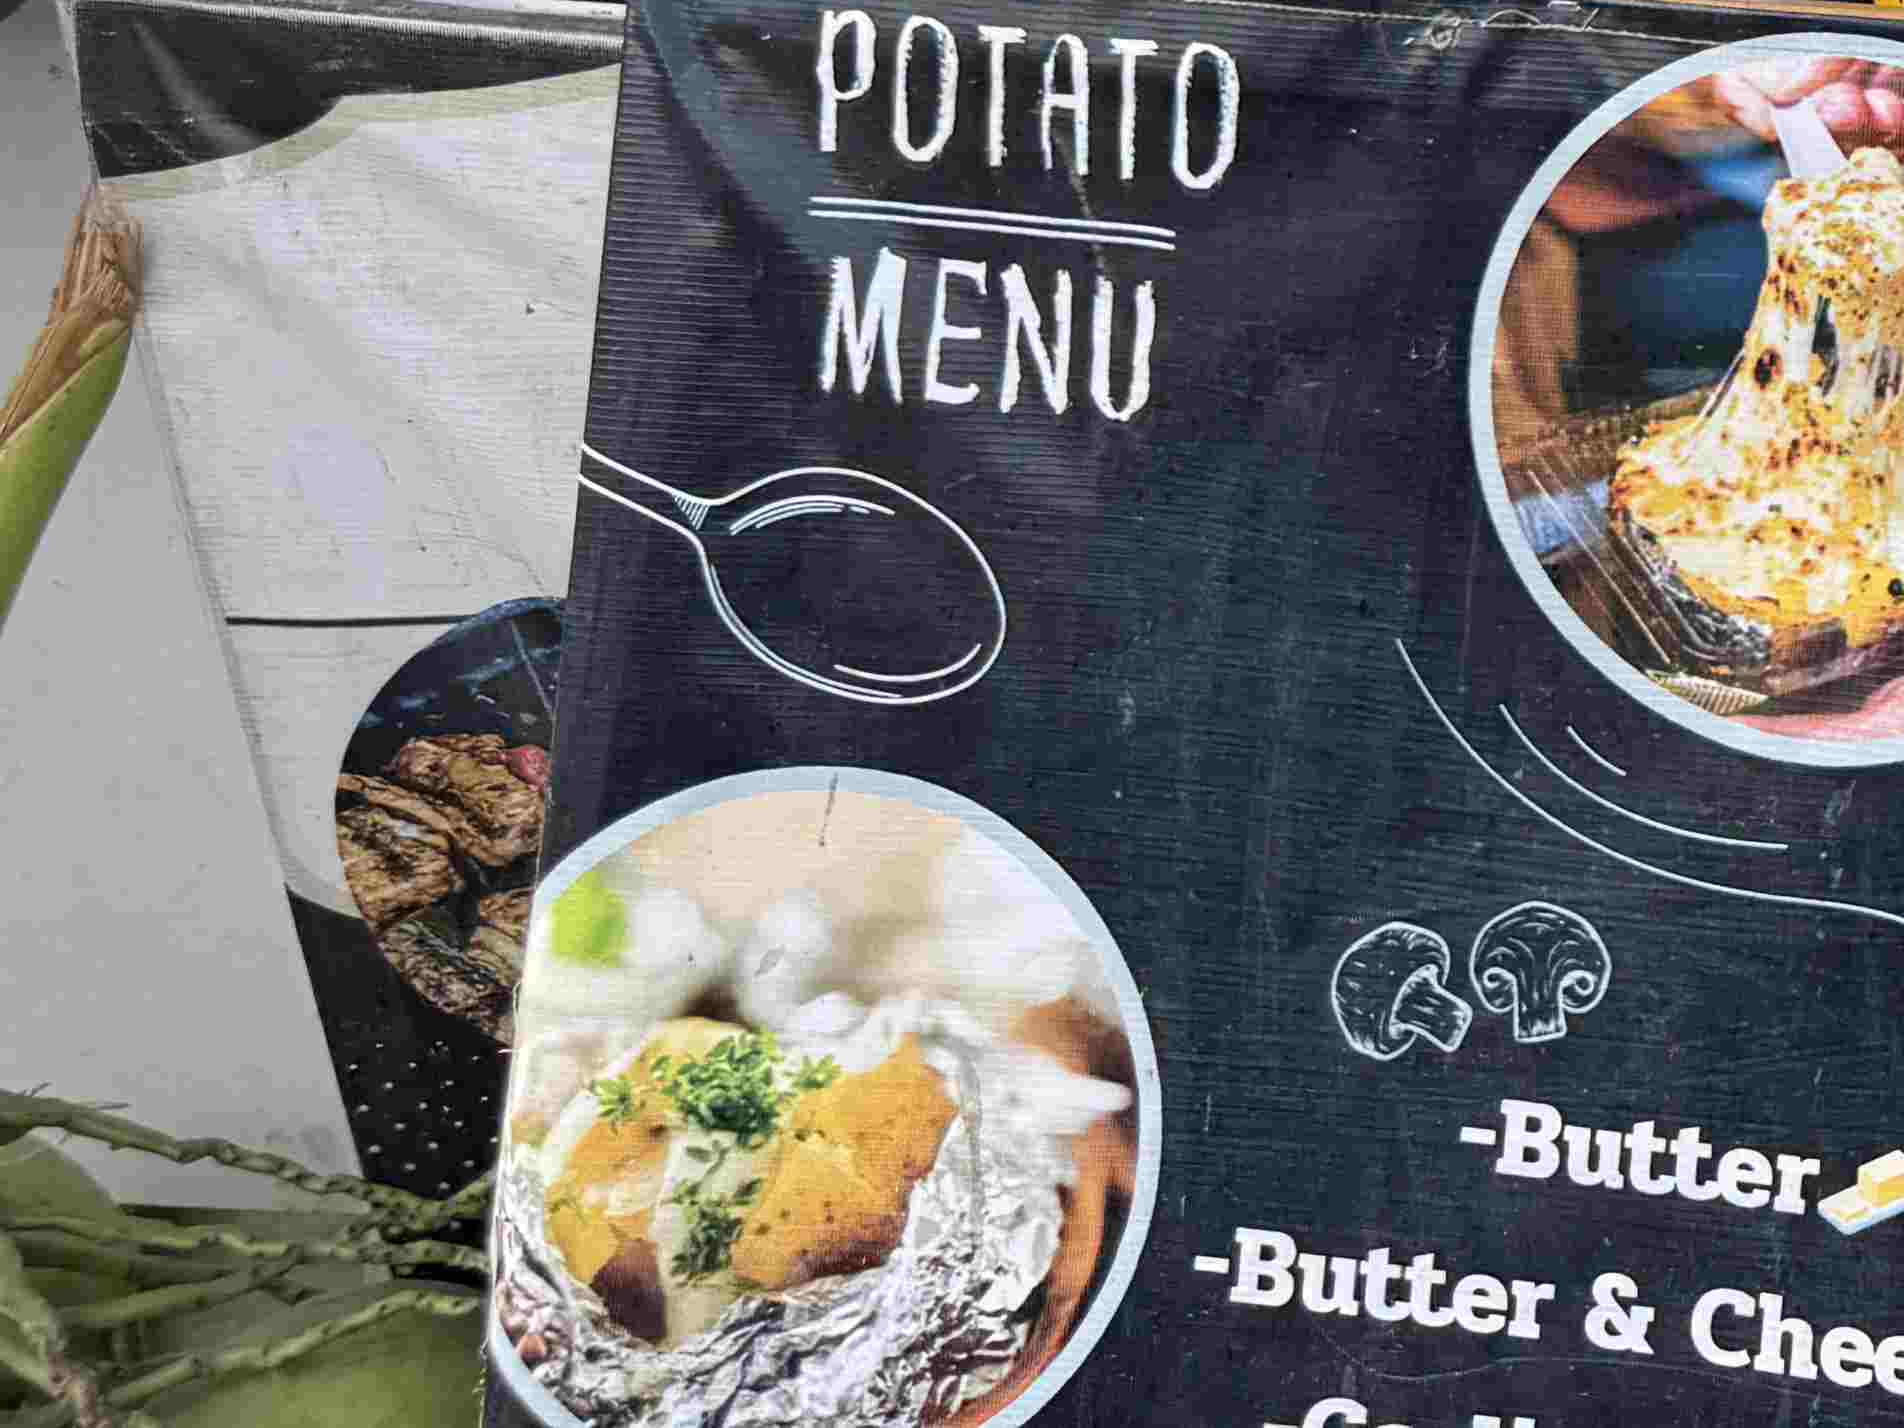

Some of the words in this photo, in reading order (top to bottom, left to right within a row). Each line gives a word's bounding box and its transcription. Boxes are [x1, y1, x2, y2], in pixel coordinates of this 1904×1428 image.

[817, 8, 1241, 191] POTATO
[817, 245, 1158, 423] MENU
[1458, 1098, 1821, 1216] -Butter
[1192, 1226, 1556, 1341] -Butter
[1584, 1271, 1656, 1356] &
